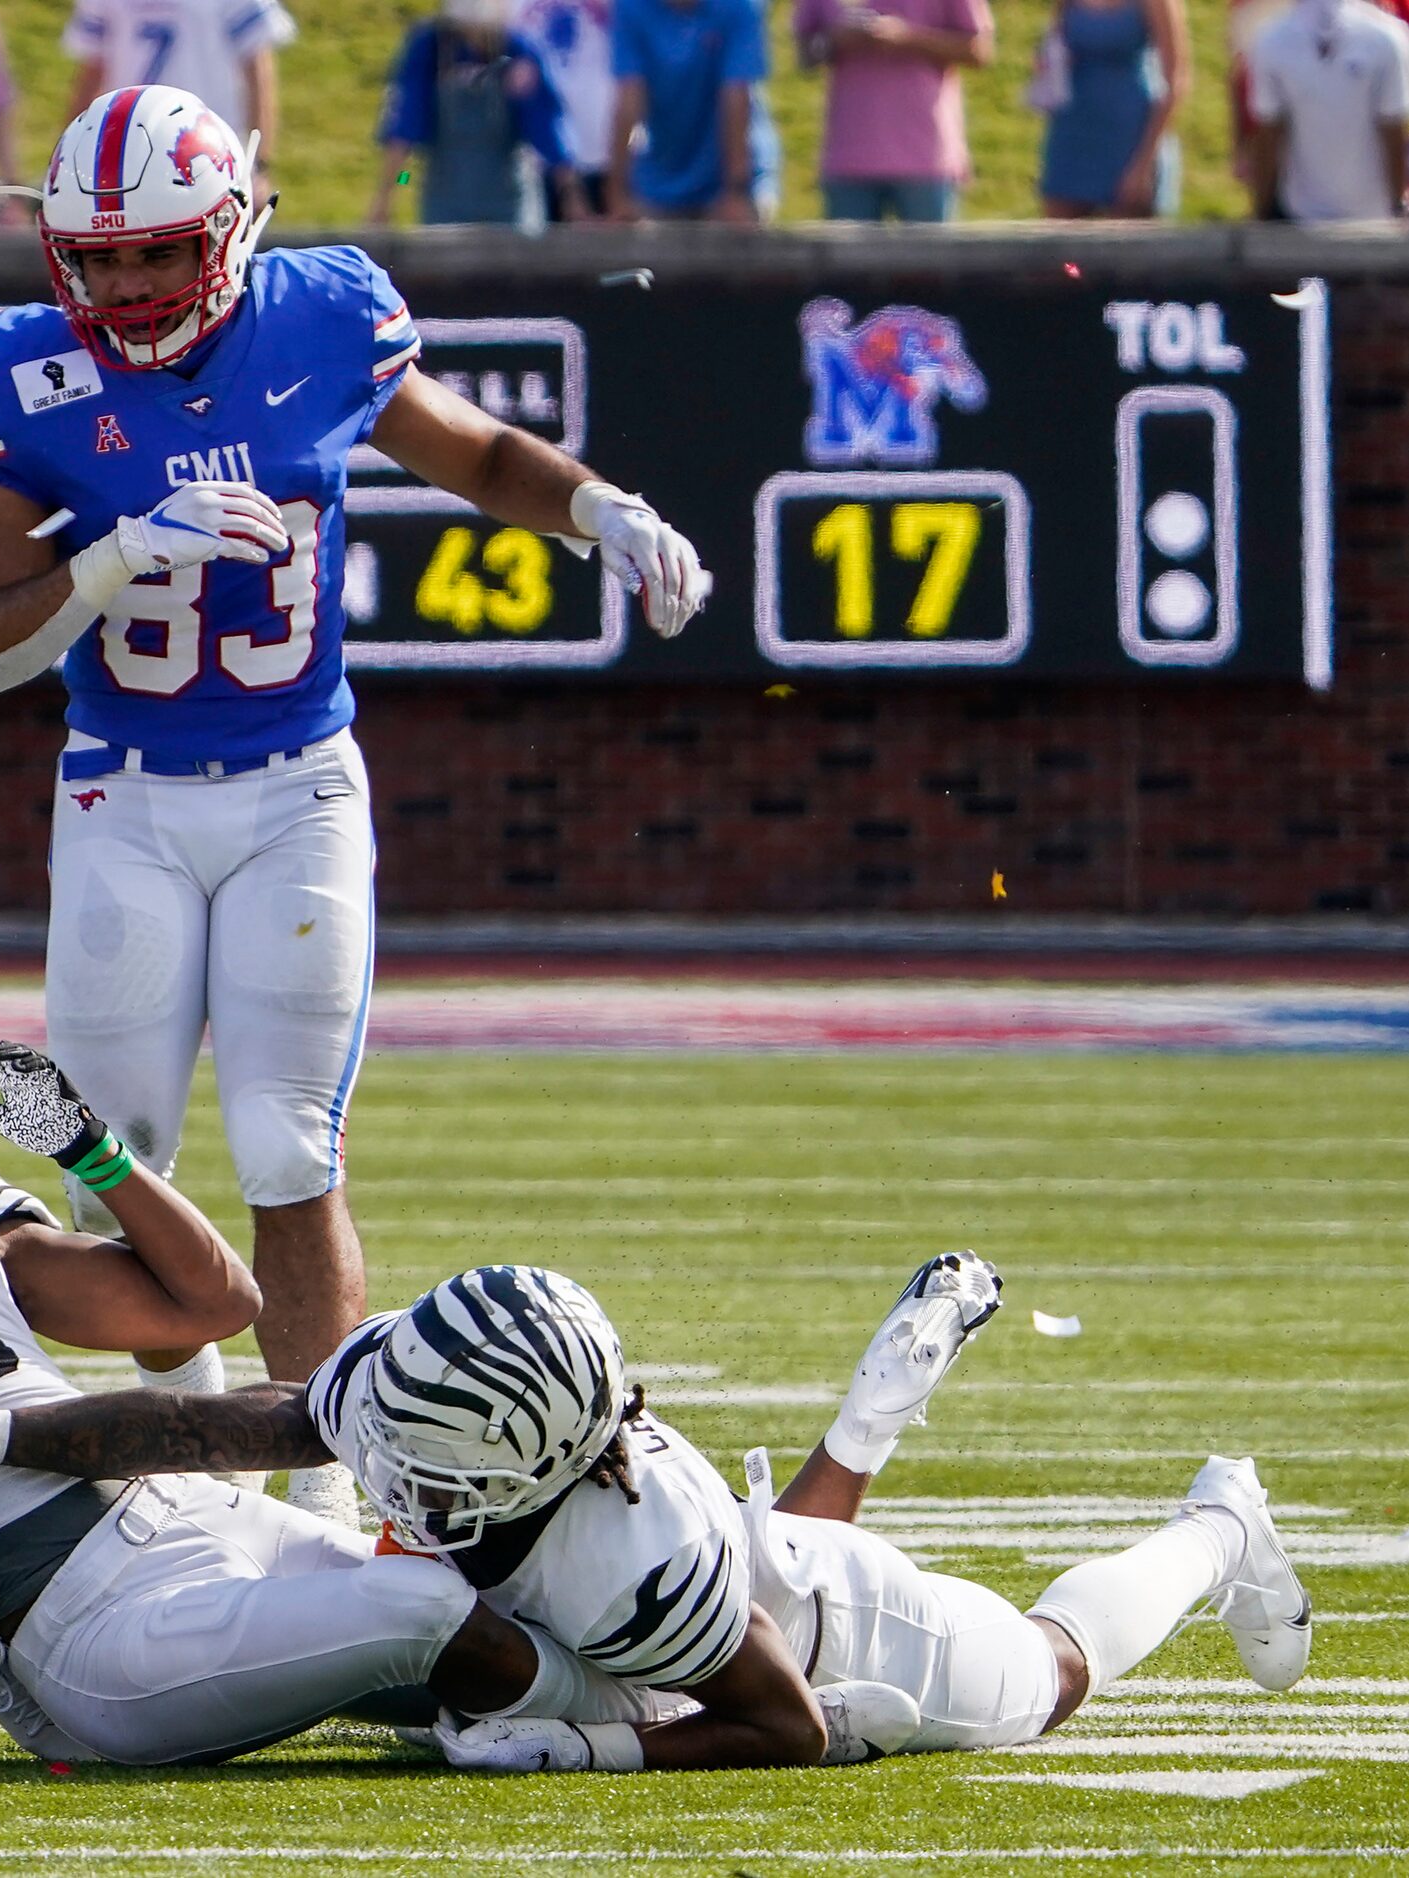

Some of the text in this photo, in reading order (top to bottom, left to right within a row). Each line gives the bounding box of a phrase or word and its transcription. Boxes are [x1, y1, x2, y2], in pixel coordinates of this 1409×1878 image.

[138, 20, 177, 85] 7
[91, 214, 125, 230] SMU
[1103, 301, 1247, 372] TOL
[33, 383, 92, 410] GREAT FAMILY
[100, 497, 319, 697] 83
[415, 527, 553, 635] 43
[812, 503, 983, 639] 17
